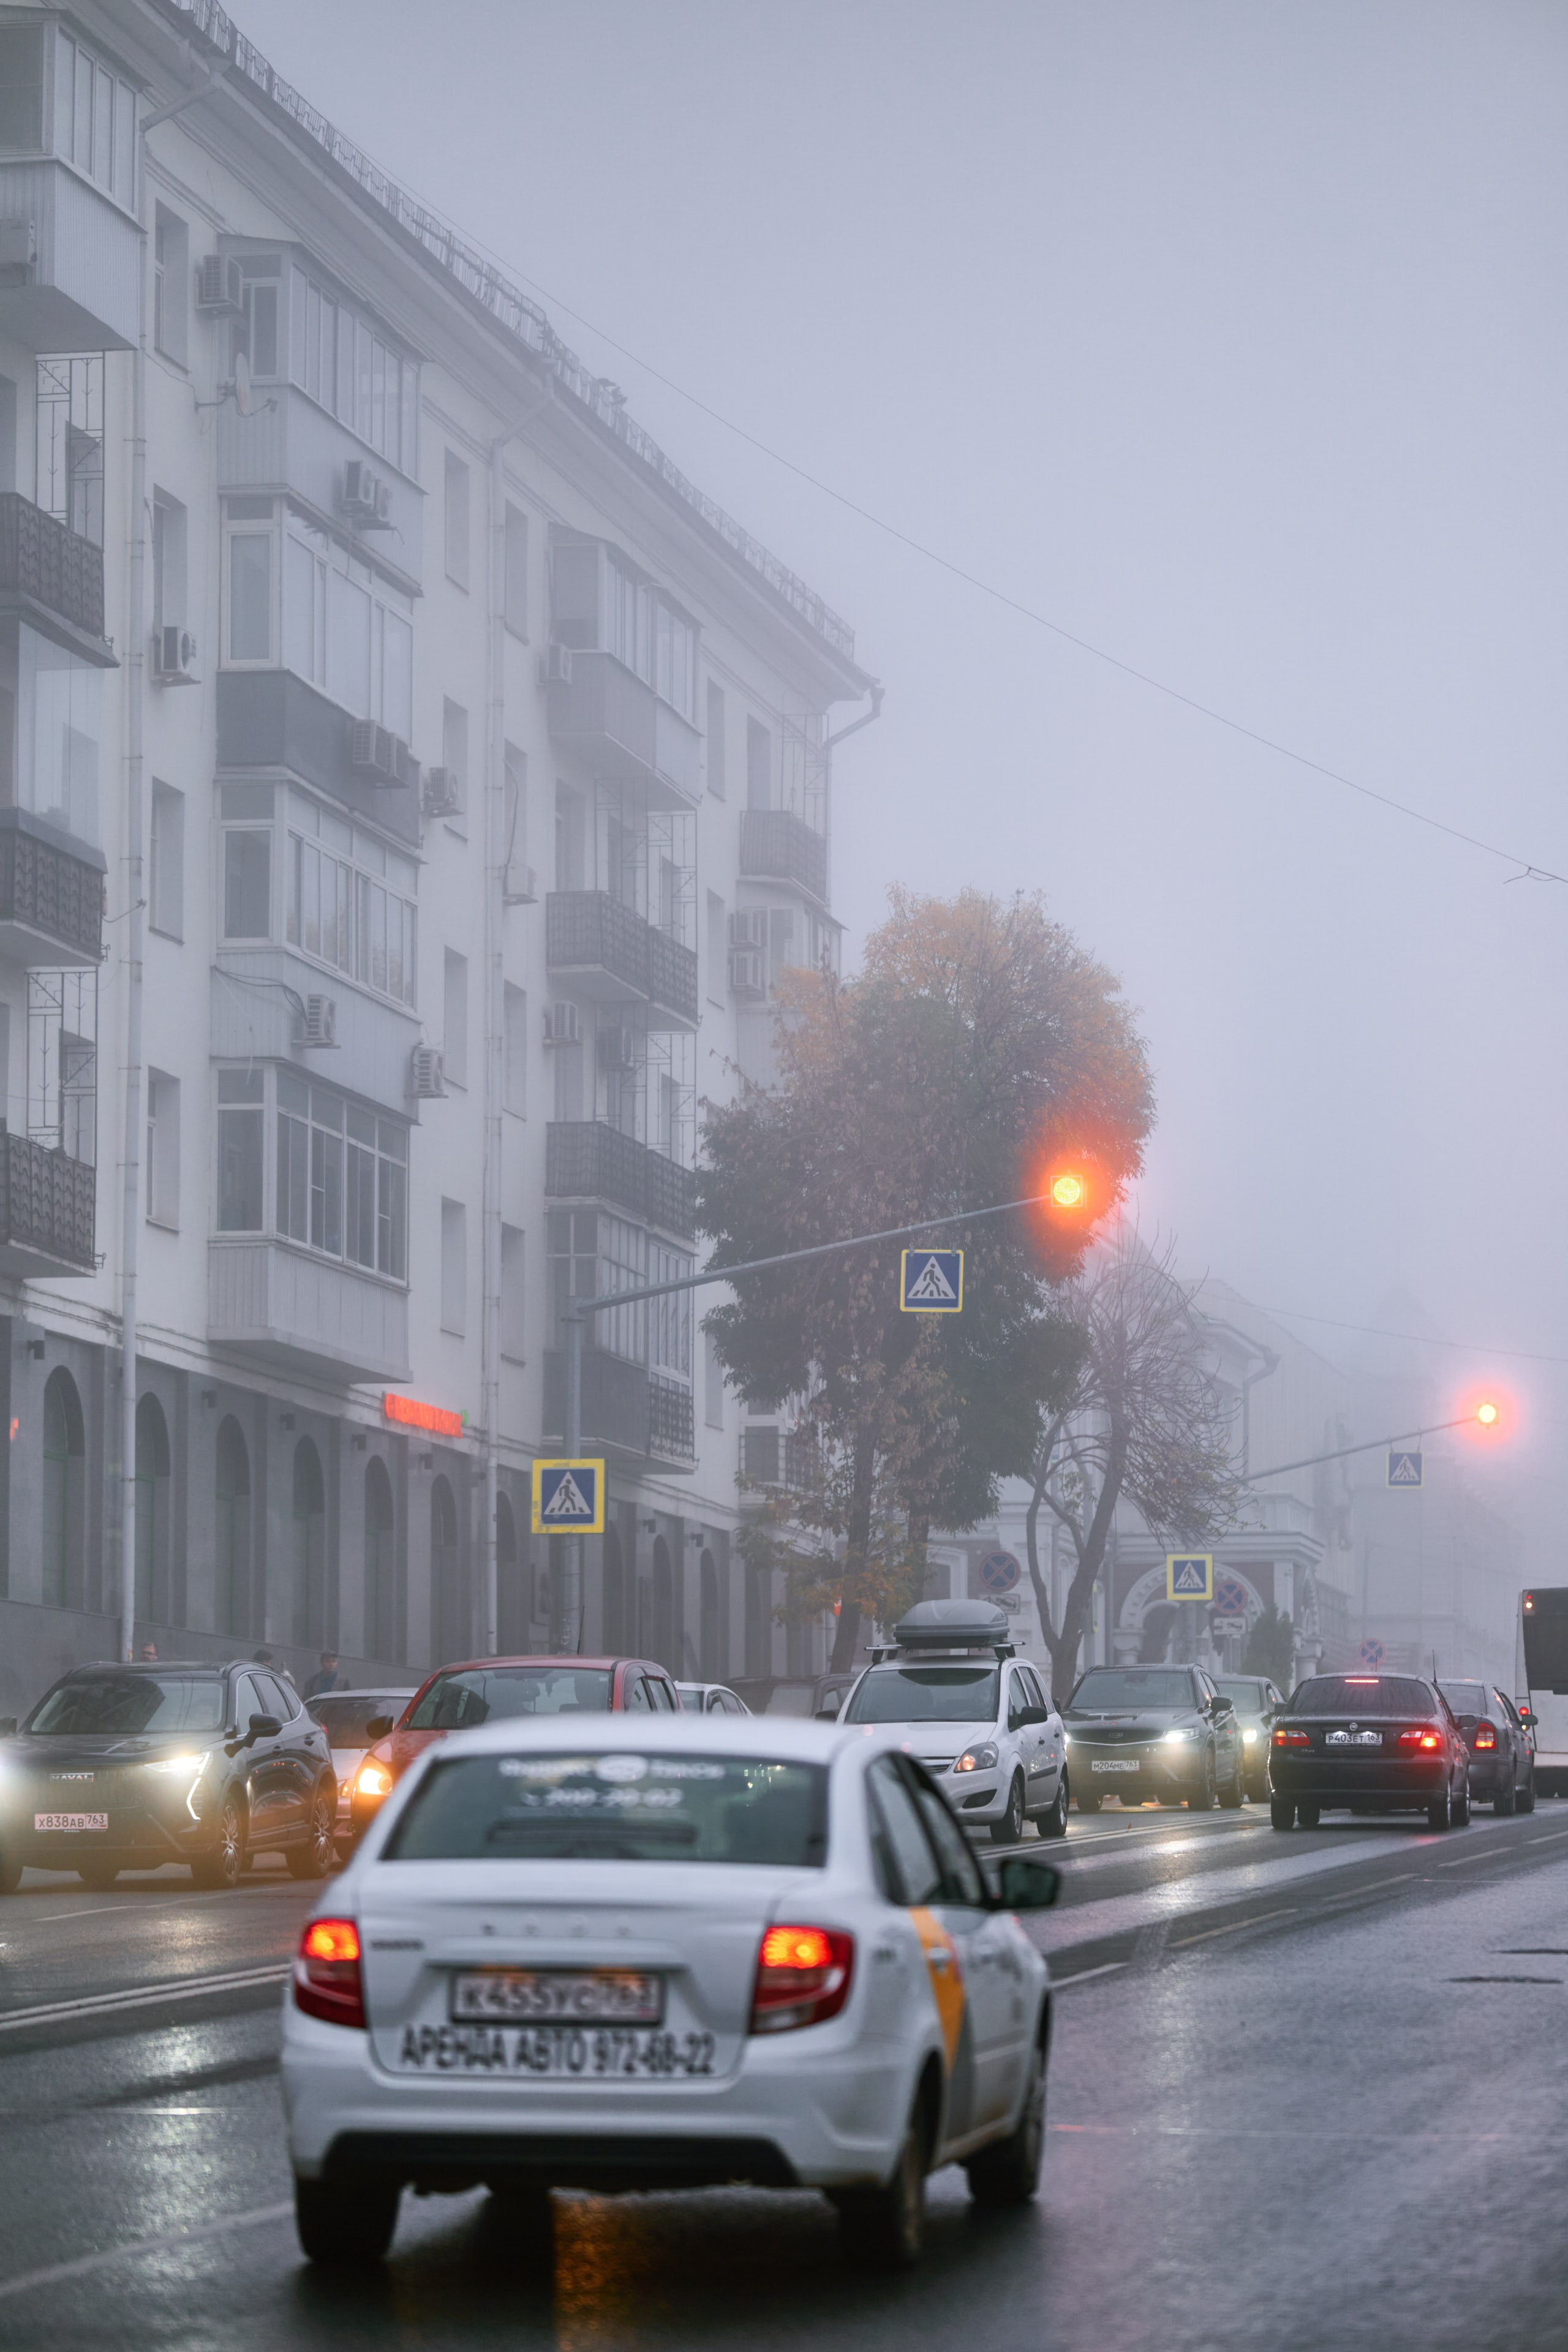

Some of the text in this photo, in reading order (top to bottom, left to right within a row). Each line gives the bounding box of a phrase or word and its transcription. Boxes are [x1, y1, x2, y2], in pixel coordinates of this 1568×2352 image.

[39, 1815, 104, 1827] Х838АВ 763
[401, 2024, 507, 2069] АРЕНДА
[513, 2030, 588, 2072] АВТО
